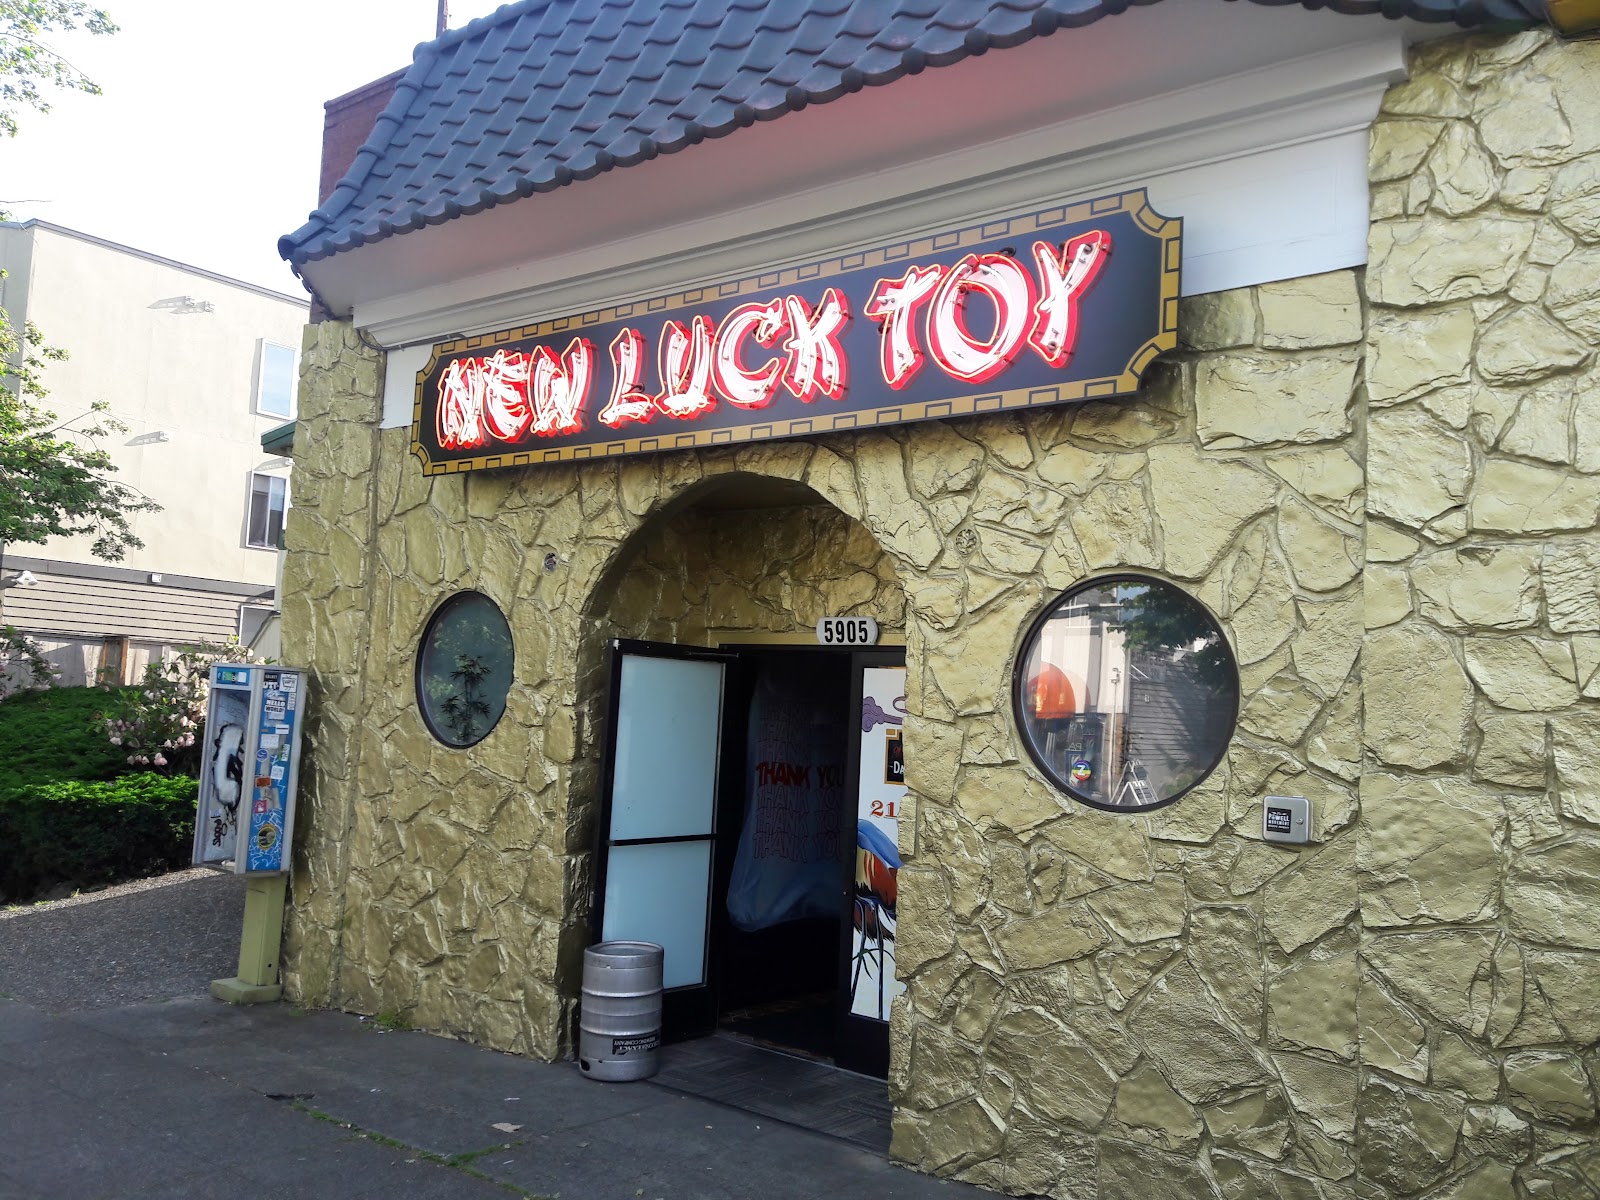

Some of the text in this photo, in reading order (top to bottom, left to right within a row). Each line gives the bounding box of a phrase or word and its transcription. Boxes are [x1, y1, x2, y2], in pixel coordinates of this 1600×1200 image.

[436, 229, 1112, 448] NEW LUCK TOY
[824, 619, 868, 643] 5905
[756, 761, 846, 789] THANK YOU
